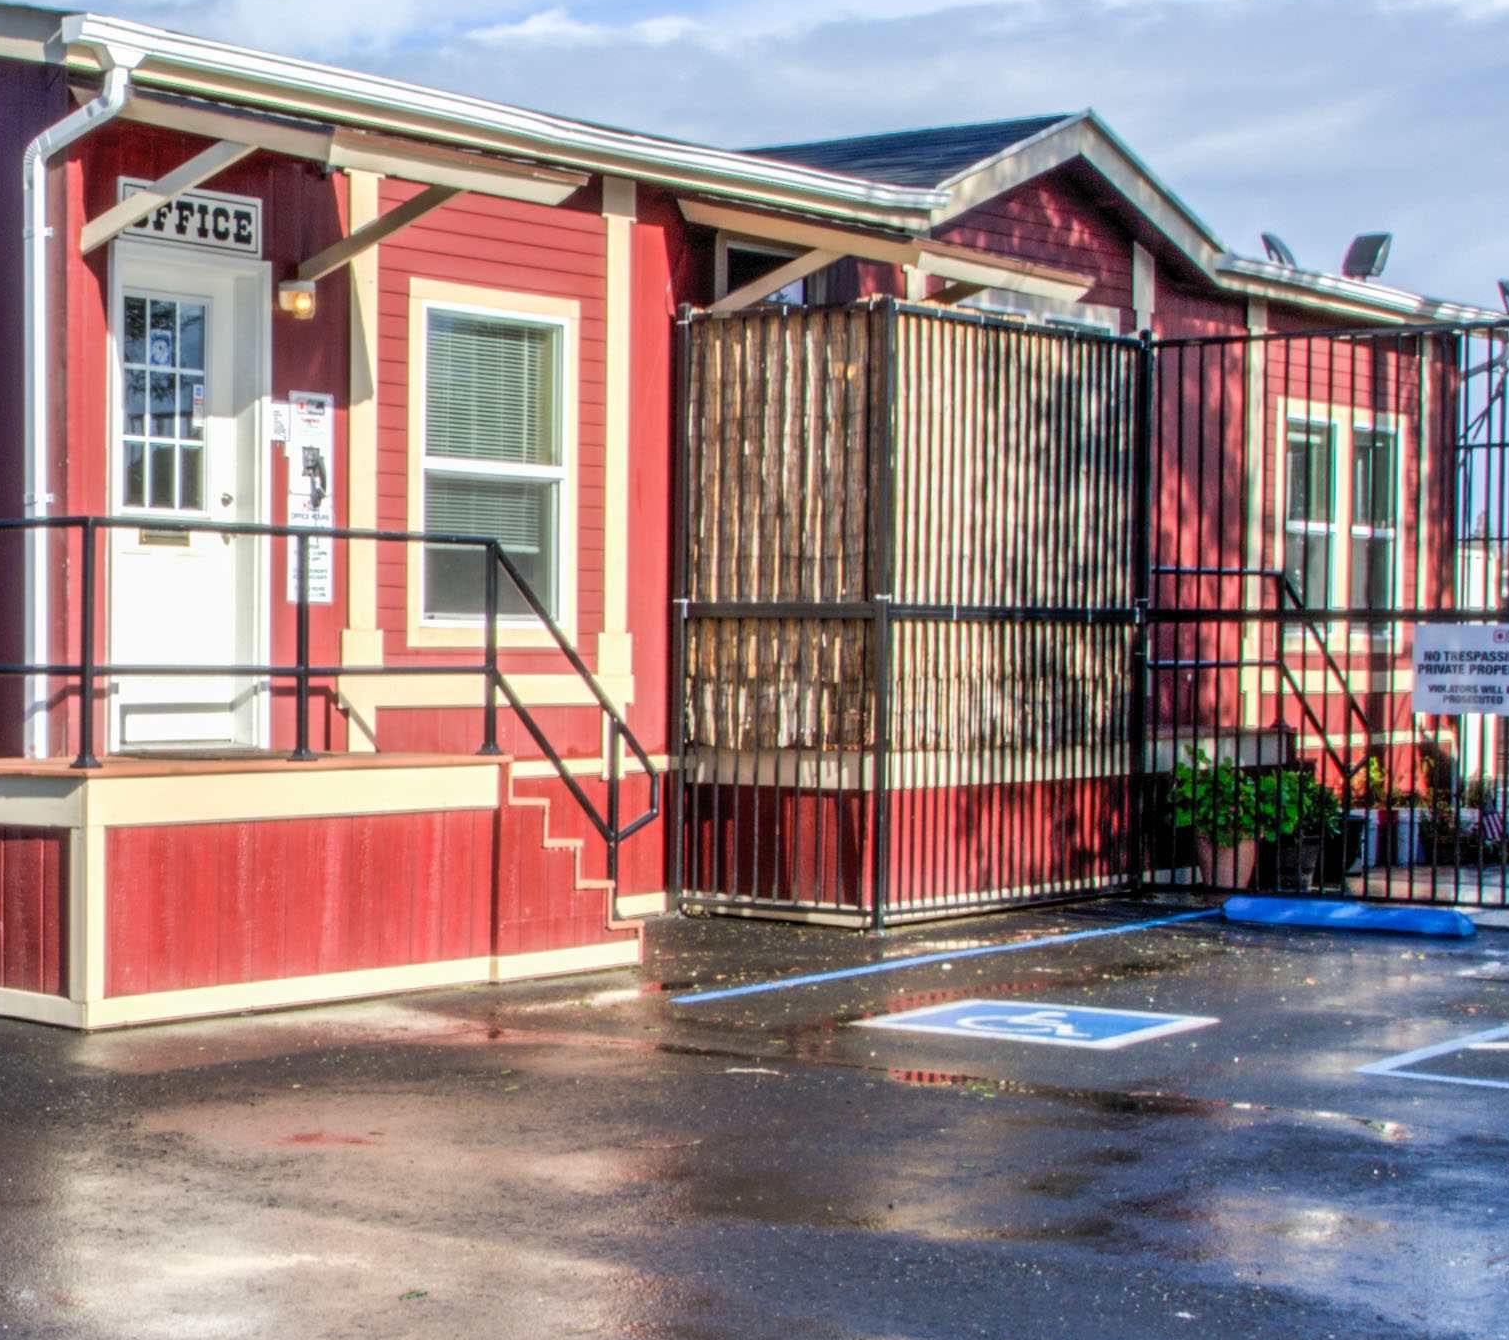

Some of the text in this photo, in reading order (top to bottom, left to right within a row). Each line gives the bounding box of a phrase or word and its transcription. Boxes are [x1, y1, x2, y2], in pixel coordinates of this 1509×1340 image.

[1423, 651, 1441, 662] NO
[1418, 663, 1466, 675] PRIVATE
[1480, 685, 1504, 695] WILL
